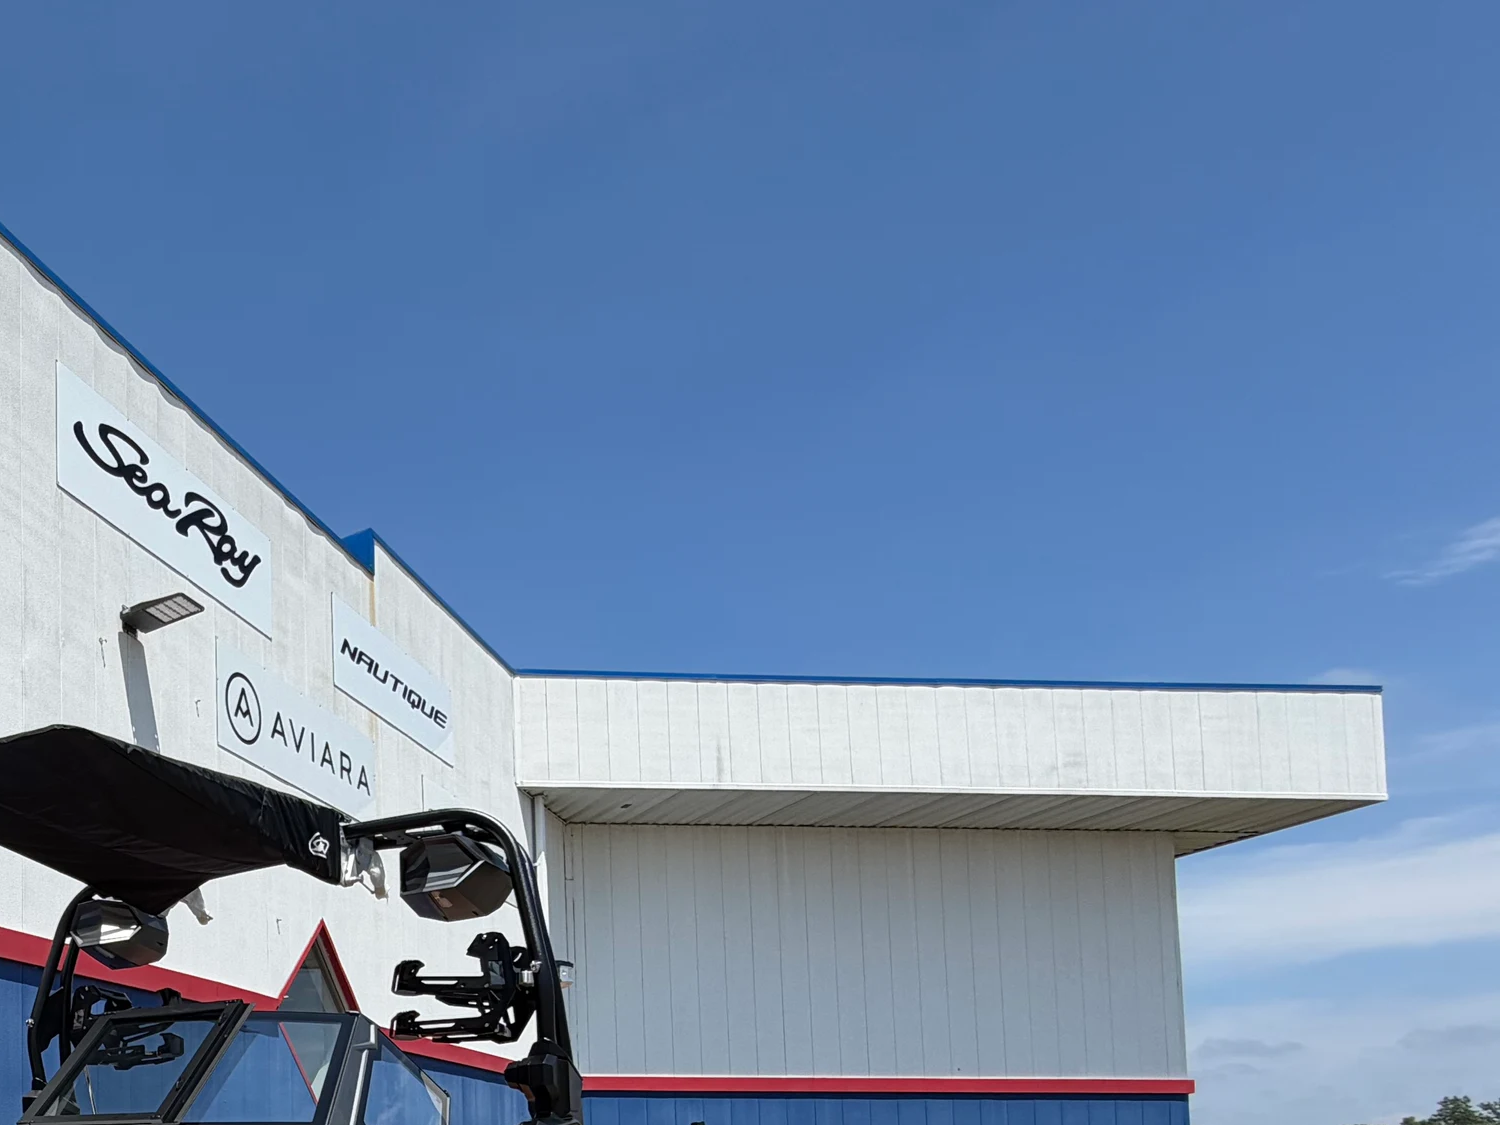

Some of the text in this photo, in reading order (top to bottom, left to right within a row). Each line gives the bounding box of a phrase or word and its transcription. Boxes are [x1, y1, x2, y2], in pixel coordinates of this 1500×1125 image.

[73, 420, 262, 588] Sea Ray
[339, 637, 448, 730] NAUTIQUE
[270, 711, 371, 797] AVIARA
